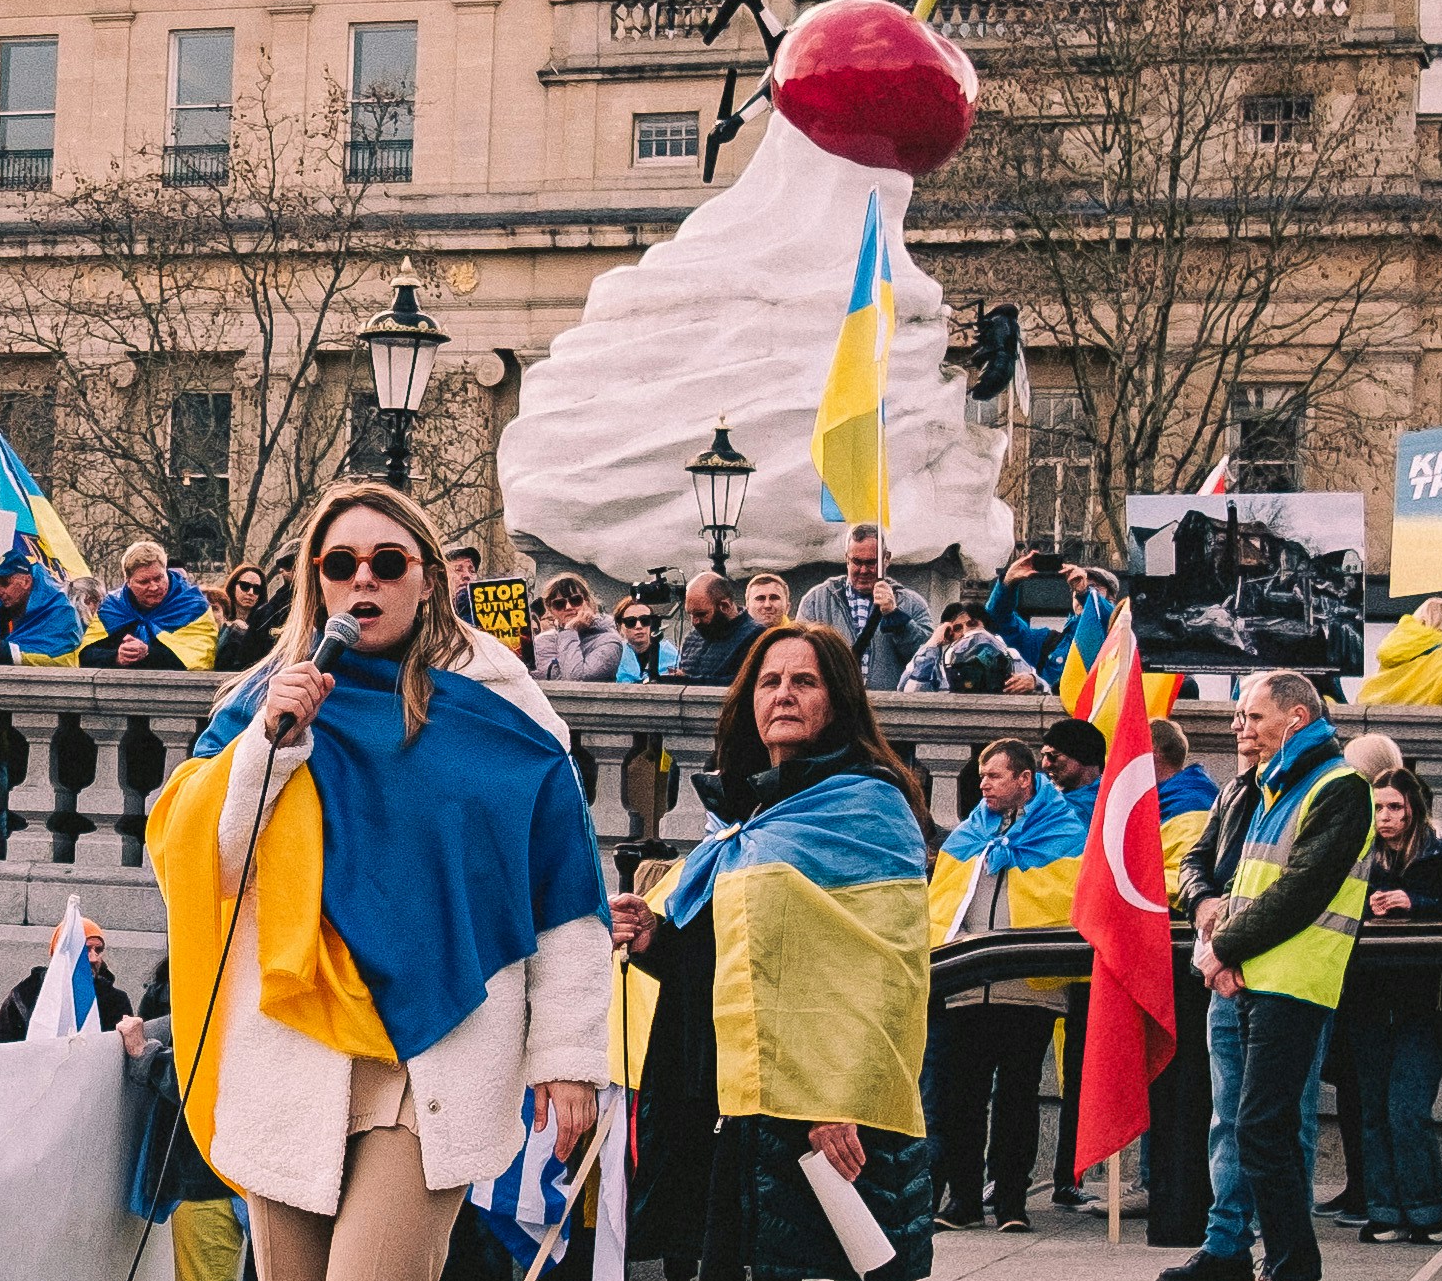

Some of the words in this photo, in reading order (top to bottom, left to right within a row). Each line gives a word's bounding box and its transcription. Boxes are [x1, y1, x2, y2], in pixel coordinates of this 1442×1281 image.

[473, 583, 525, 602] STOP
[475, 599, 526, 612] PUTIN'S
[476, 610, 528, 632] WAR
